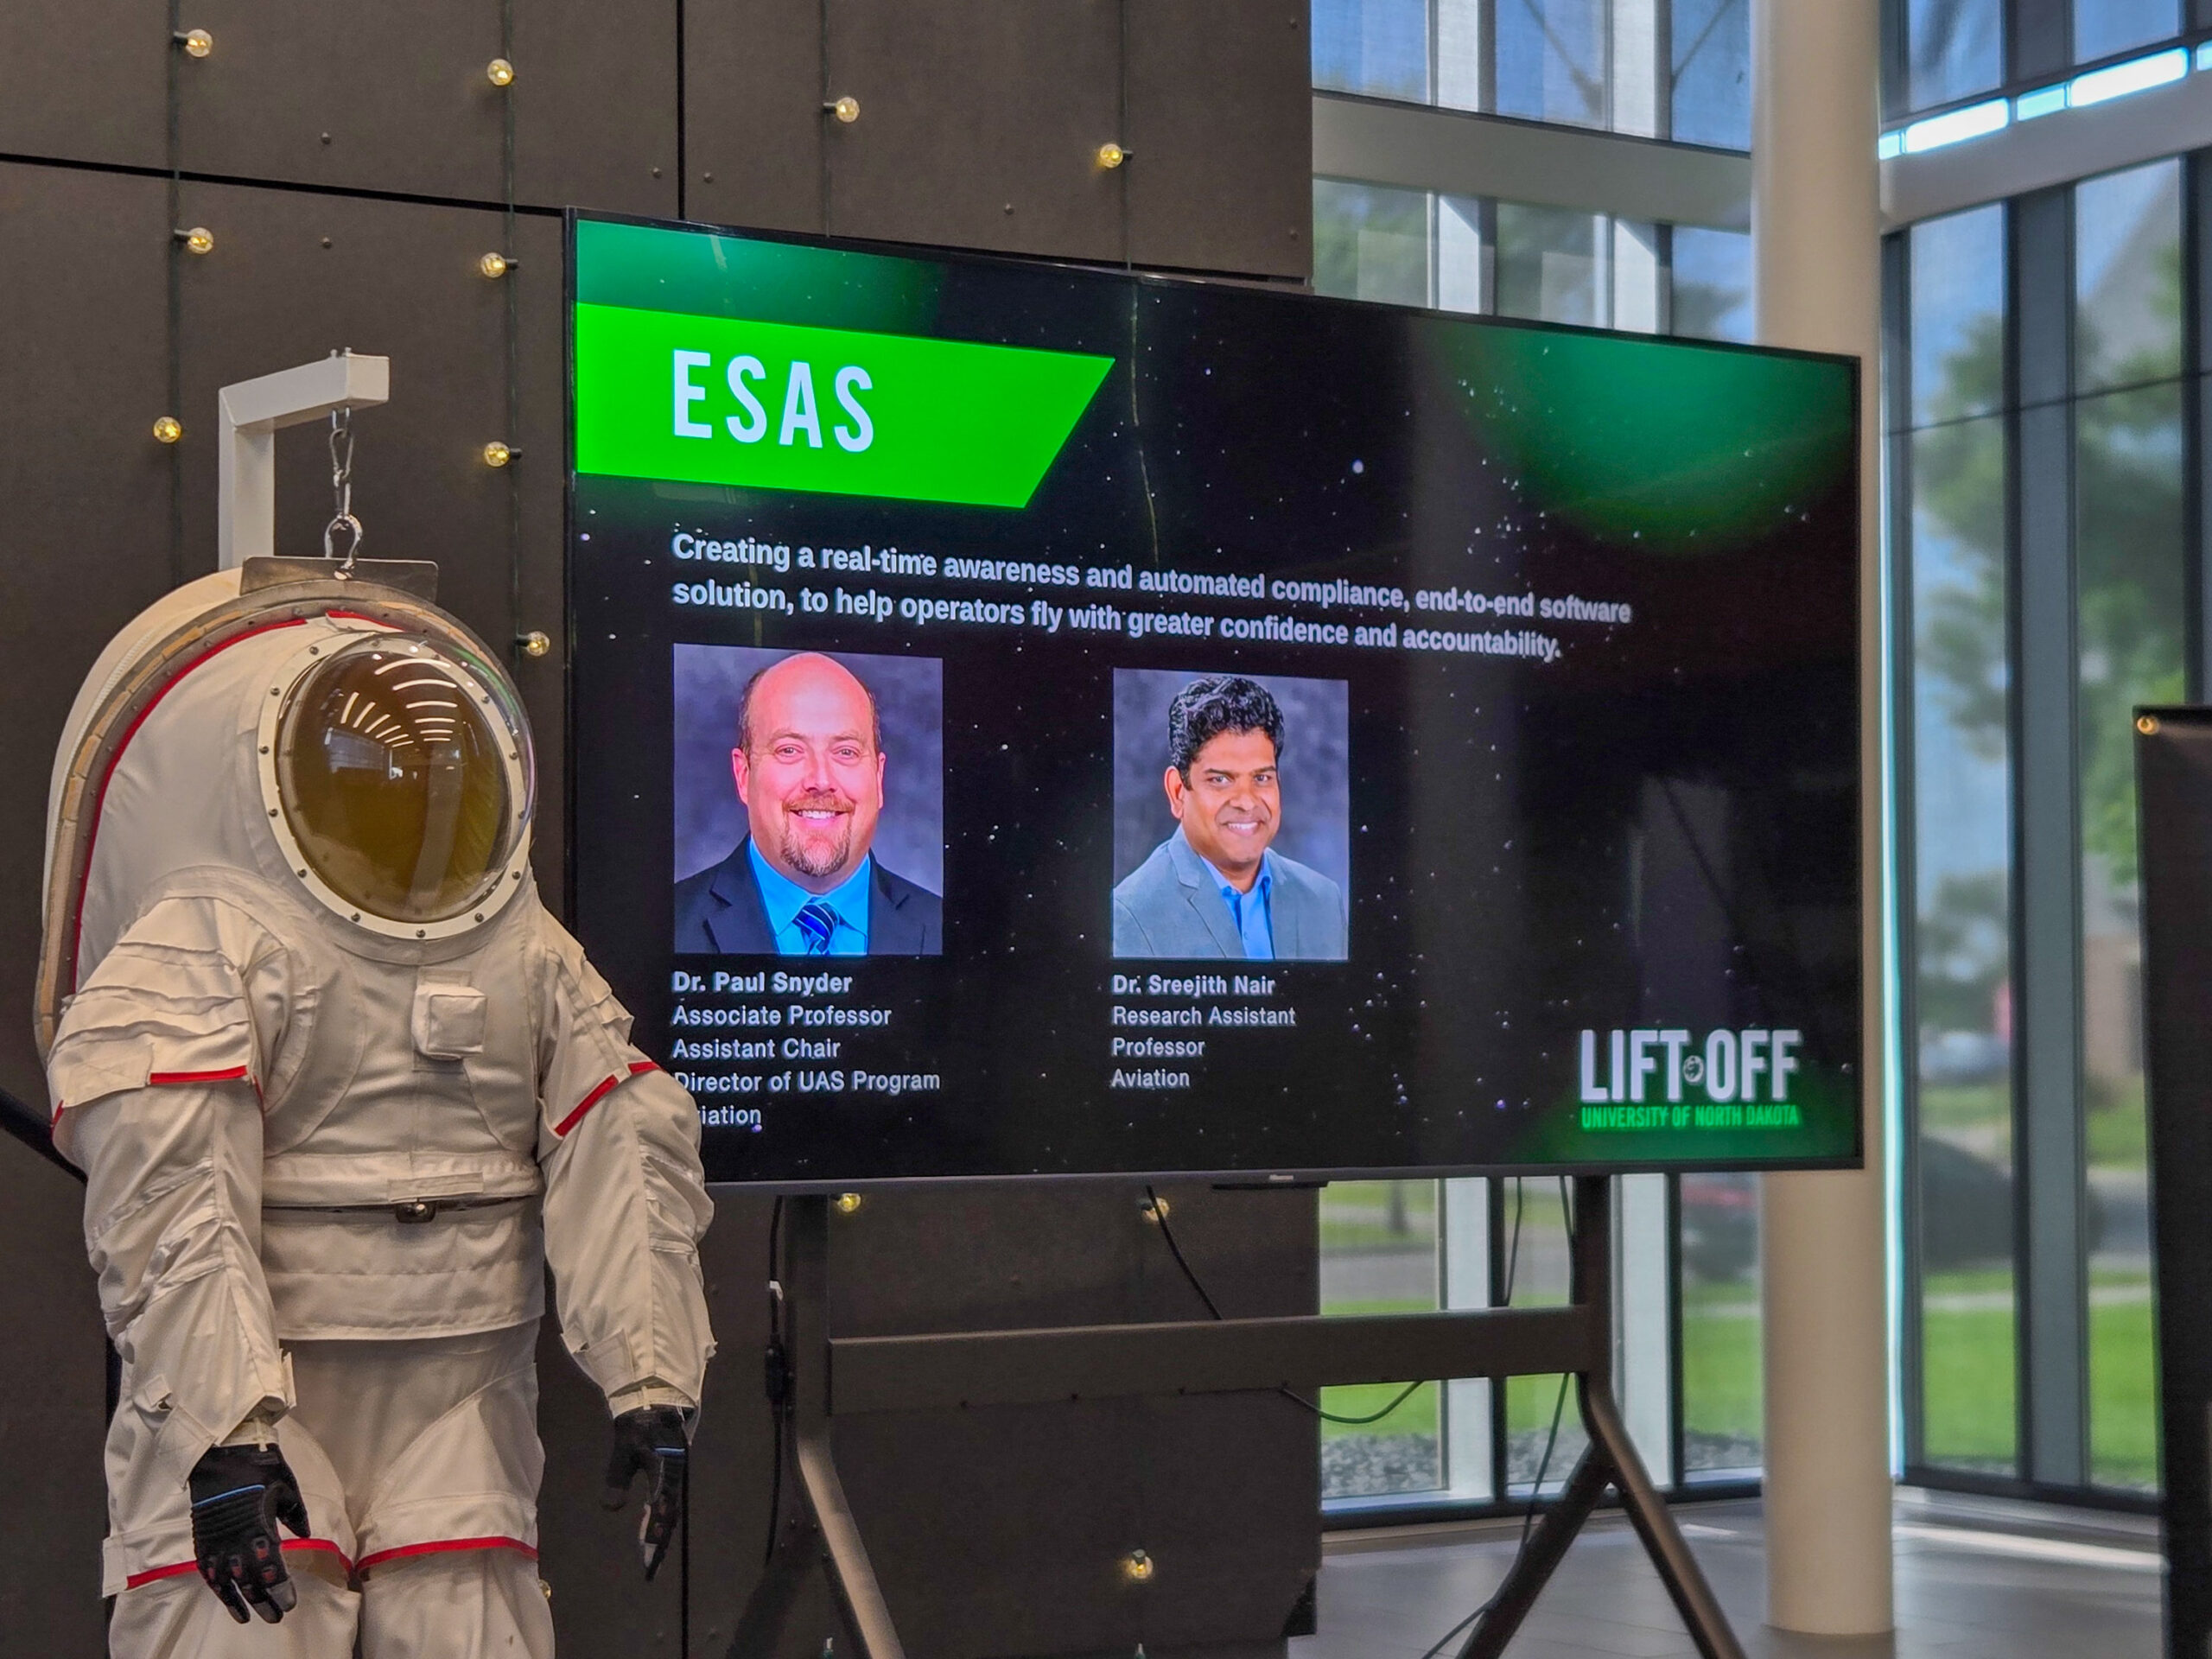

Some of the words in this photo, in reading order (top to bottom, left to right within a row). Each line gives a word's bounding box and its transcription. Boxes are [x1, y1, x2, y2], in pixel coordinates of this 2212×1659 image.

[672, 349, 875, 454] ESAS
[672, 533, 791, 573] Creating
[798, 547, 816, 569] a
[822, 544, 938, 576] real-time
[944, 558, 1080, 587] awareness
[1086, 563, 1134, 589] and
[1139, 569, 1266, 599] automated
[1271, 578, 1410, 613] compliance,
[1415, 587, 1535, 617] end-to-end
[1540, 594, 1632, 623] software
[672, 579, 794, 615] solution,
[800, 587, 829, 613] to
[836, 587, 893, 623] help
[900, 597, 1026, 626] operators
[1031, 601, 1064, 633] fly
[1069, 604, 1122, 631] with
[1128, 610, 1215, 638] greater
[1220, 615, 1349, 645] confidence
[1354, 622, 1397, 648] and
[1402, 628, 1562, 663] accountability.
[672, 971, 706, 993] Dr.
[713, 971, 766, 993] Paul
[772, 971, 854, 997] Snyder
[1111, 975, 1142, 995] Dr.
[1147, 975, 1228, 999] Sreejith
[1234, 976, 1276, 995] Nair
[671, 1005, 782, 1027] Associate
[788, 1005, 893, 1026] Professor
[1111, 1006, 1203, 1026] Research
[1208, 1006, 1296, 1027] Assistant
[671, 1038, 775, 1060] Assistant
[781, 1038, 842, 1059] Chair
[1111, 1037, 1205, 1058] Professor
[674, 1071, 763, 1092] Director
[769, 1071, 791, 1092] of
[798, 1071, 845, 1092] UAS
[851, 1070, 941, 1096] Program
[1111, 1068, 1191, 1089] Aviation
[697, 1104, 762, 1126] iation
[1581, 1106, 1669, 1129] UNIVERSITY
[1672, 1105, 1691, 1128] OF
[1695, 1105, 1743, 1127] NORTH
[1745, 1104, 1800, 1127] DAKOTA
